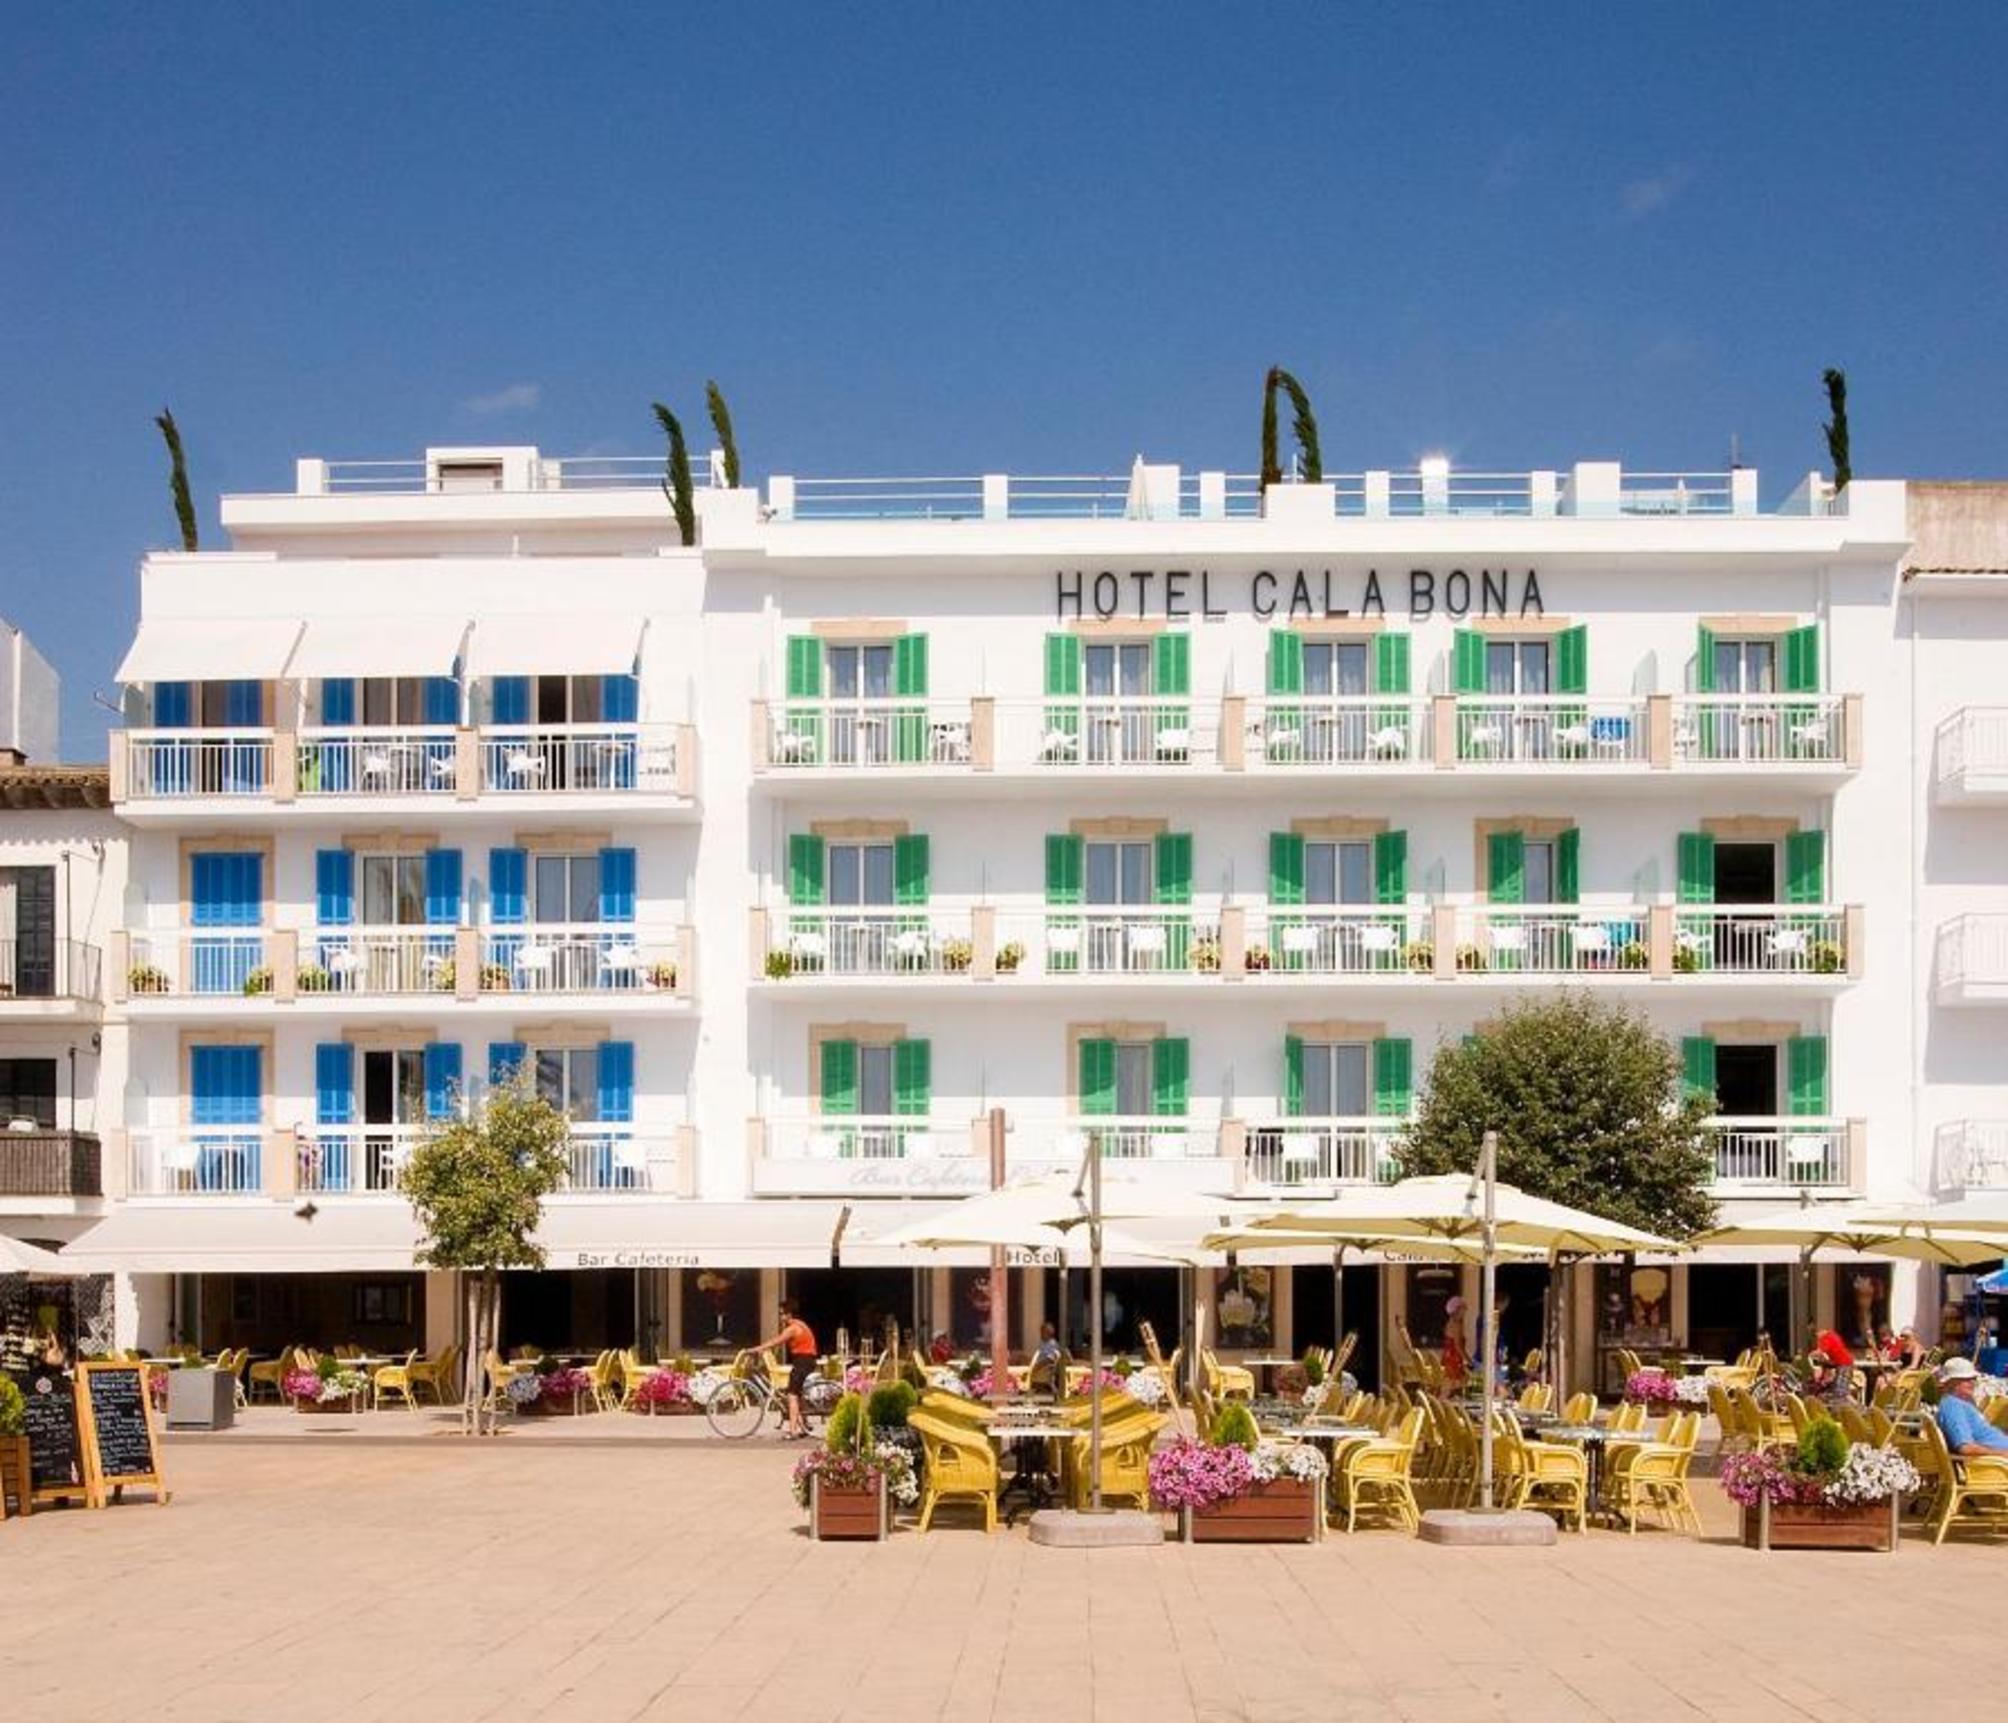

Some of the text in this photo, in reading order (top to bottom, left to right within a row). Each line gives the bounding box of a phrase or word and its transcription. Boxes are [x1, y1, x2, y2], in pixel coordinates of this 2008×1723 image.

[1057, 569, 1544, 619] HOTEL CALA BONA
[577, 1251, 699, 1266] Bar Cafeteria
[1006, 1250, 1058, 1264] Hotel
